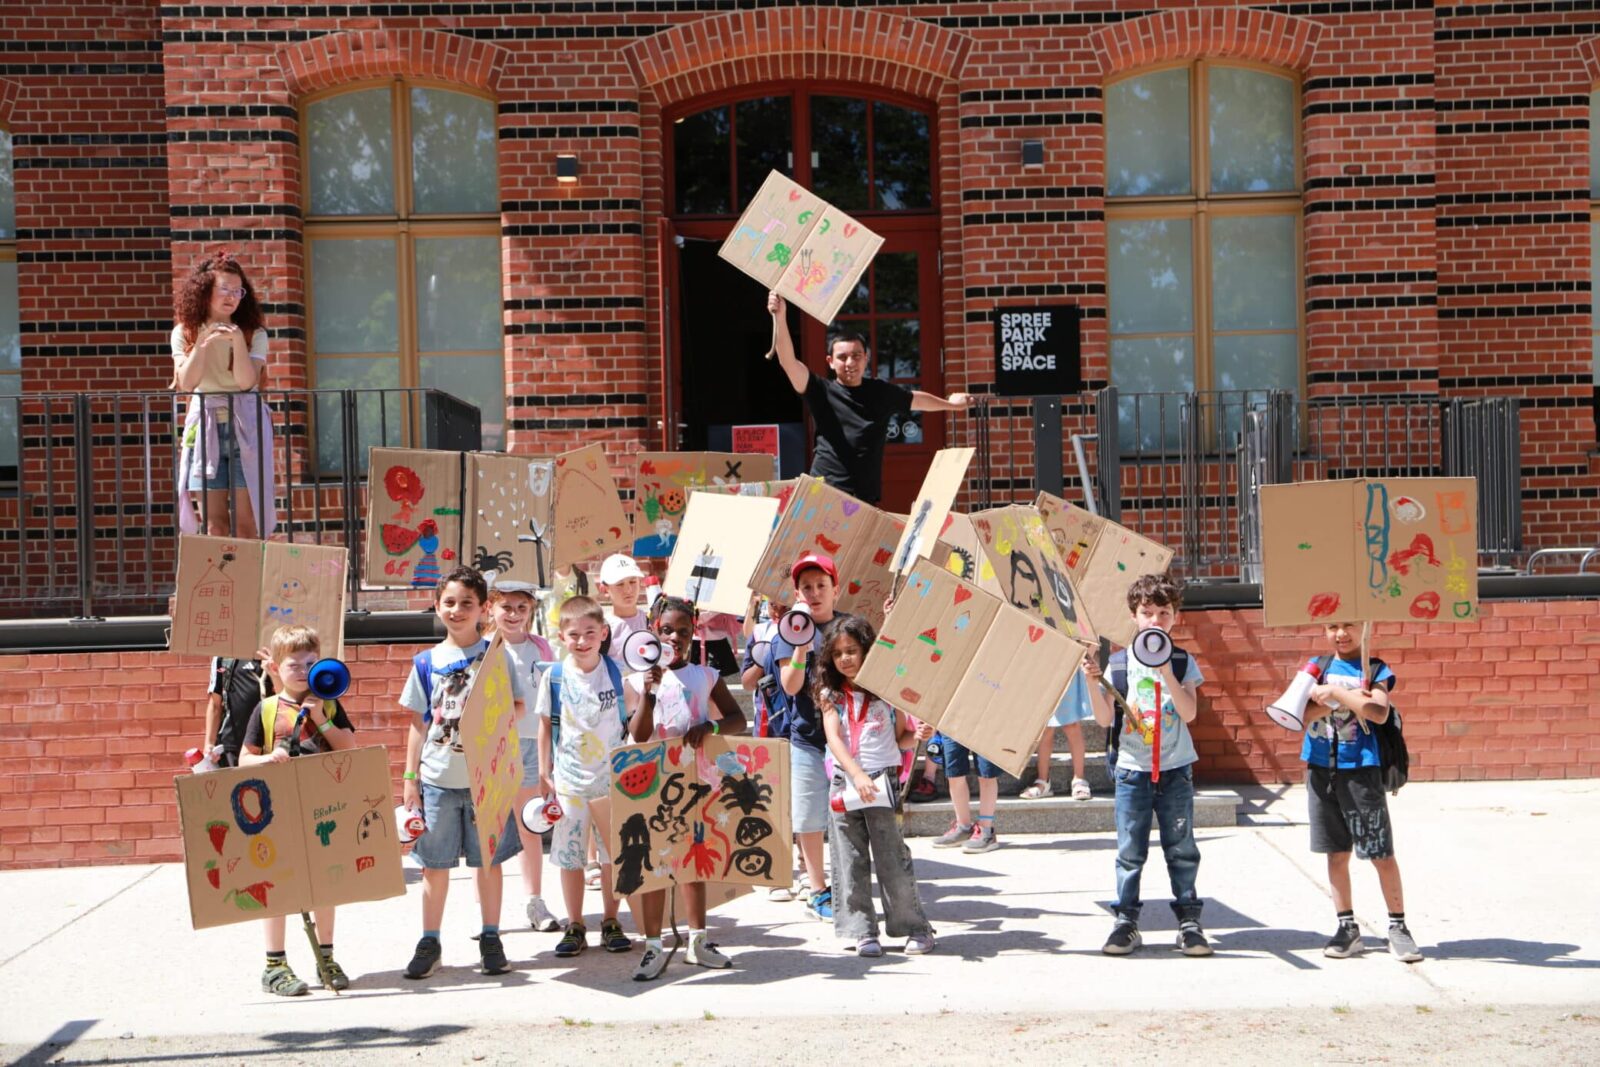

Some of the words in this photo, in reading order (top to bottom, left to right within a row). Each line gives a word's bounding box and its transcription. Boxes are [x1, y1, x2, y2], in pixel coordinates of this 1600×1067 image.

[1001, 312, 1052, 328] SPREE
[1001, 327, 1046, 342] PARK
[1001, 342, 1034, 357] ART
[1001, 355, 1056, 371] SPACE
[661, 773, 711, 815] 67
